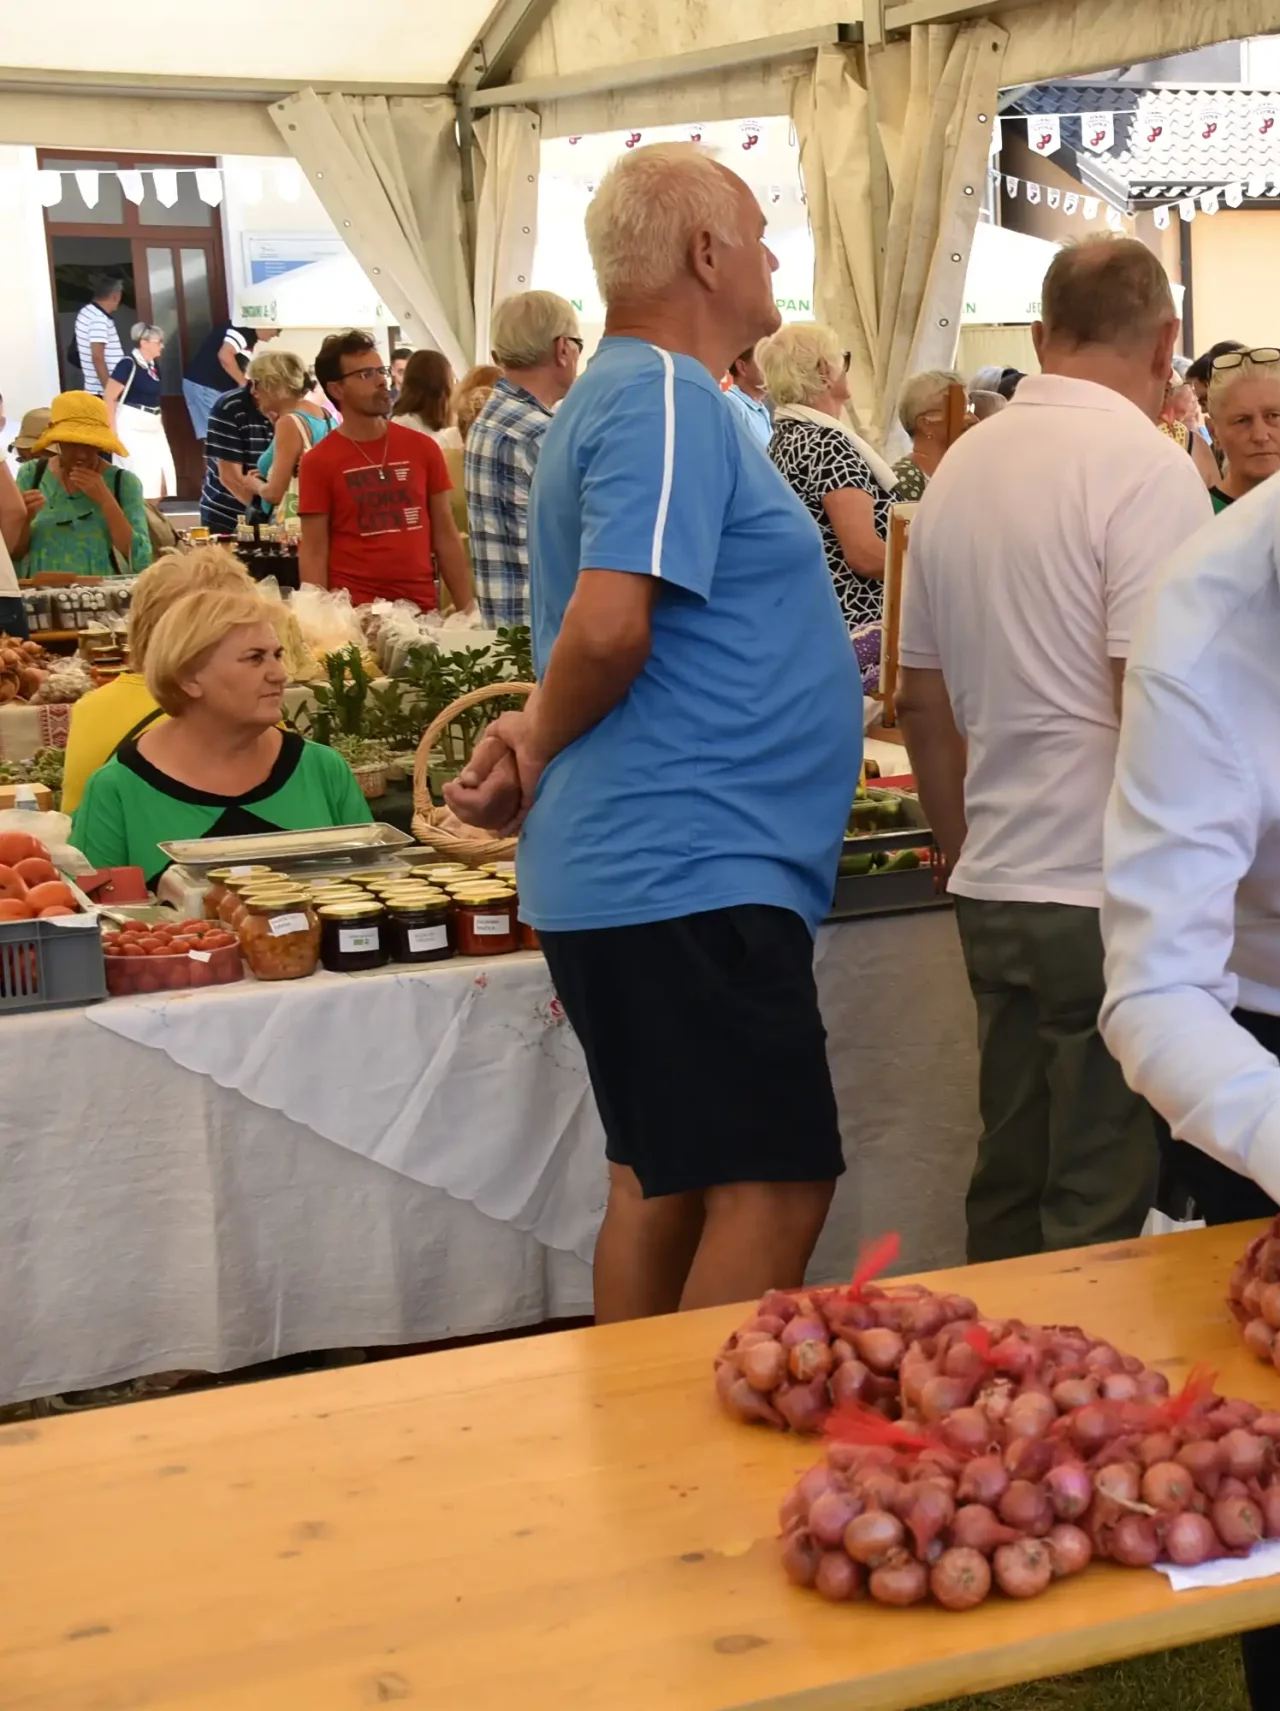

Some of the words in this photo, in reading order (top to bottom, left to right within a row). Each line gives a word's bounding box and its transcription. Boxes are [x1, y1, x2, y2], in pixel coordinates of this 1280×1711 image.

[775, 299, 810, 311] PAN
[353, 490, 413, 511] YORK
[358, 510, 402, 530] CITY
